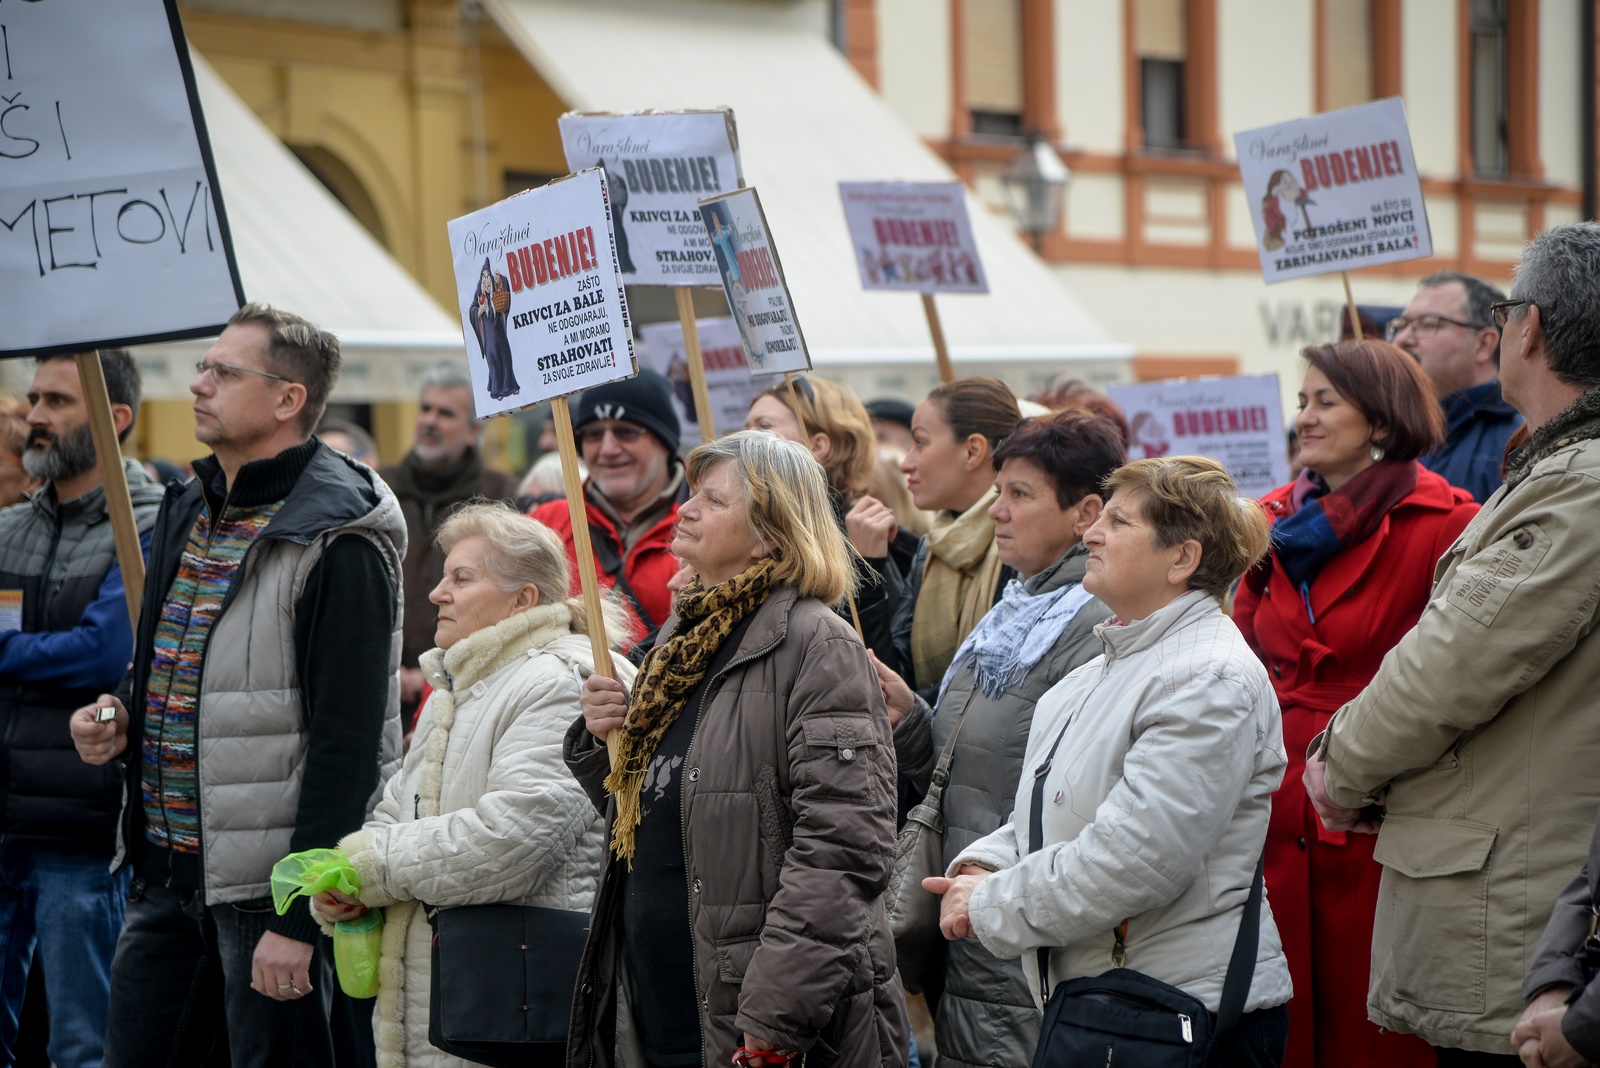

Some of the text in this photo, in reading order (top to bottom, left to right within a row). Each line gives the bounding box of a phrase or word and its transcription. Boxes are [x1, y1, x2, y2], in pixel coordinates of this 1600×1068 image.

[1300, 139, 1404, 192] BUĐENJE!
[630, 210, 672, 222] KRIVCI
[674, 210, 690, 222] ZA
[1371, 198, 1412, 214] NA ŠTO SU
[667, 224, 678, 234] NE
[1293, 210, 1414, 242] POTROŠENI NOVCI
[464, 222, 531, 262] Varaždinci
[684, 238, 690, 247] A
[690, 238, 698, 247] MI
[506, 226, 598, 293] BUĐENJE!
[656, 250, 716, 262] STRAHOV
[661, 264, 670, 274] ZA
[672, 264, 695, 274] SVOJE
[1274, 244, 1374, 272] ZBRINJAVANJE
[577, 275, 601, 292] ZAŠTO
[512, 289, 605, 330] KRIVCI ZA BALE
[548, 307, 608, 334] NE ODGOVARAJU,
[564, 323, 611, 346] A MI MORAMO
[537, 336, 614, 372] STRAHOVATI
[543, 352, 616, 385] ZA SVOJE ZDRAVLJE!
